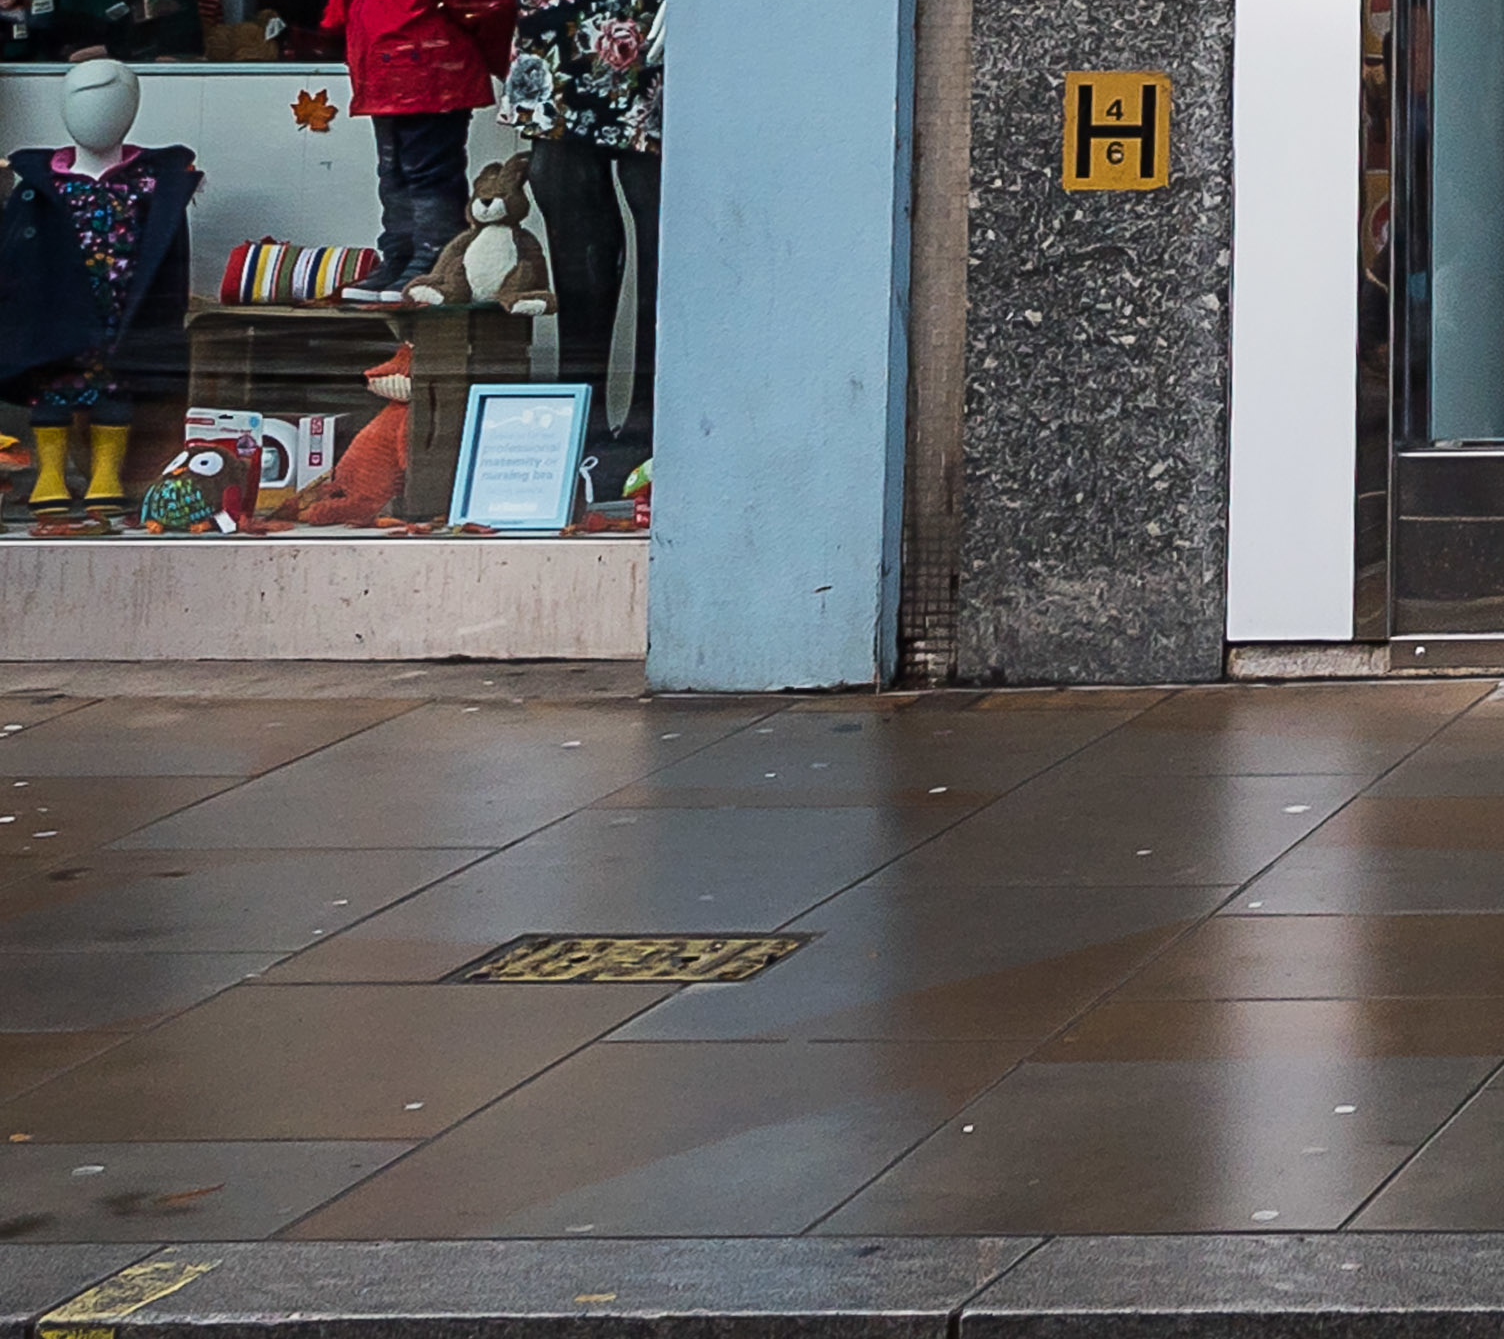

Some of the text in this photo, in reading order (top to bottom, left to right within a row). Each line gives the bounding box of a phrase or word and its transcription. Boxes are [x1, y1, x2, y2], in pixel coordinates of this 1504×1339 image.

[1106, 99, 1124, 121] 4
[1076, 85, 1156, 179] H
[1106, 141, 1124, 165] 6
